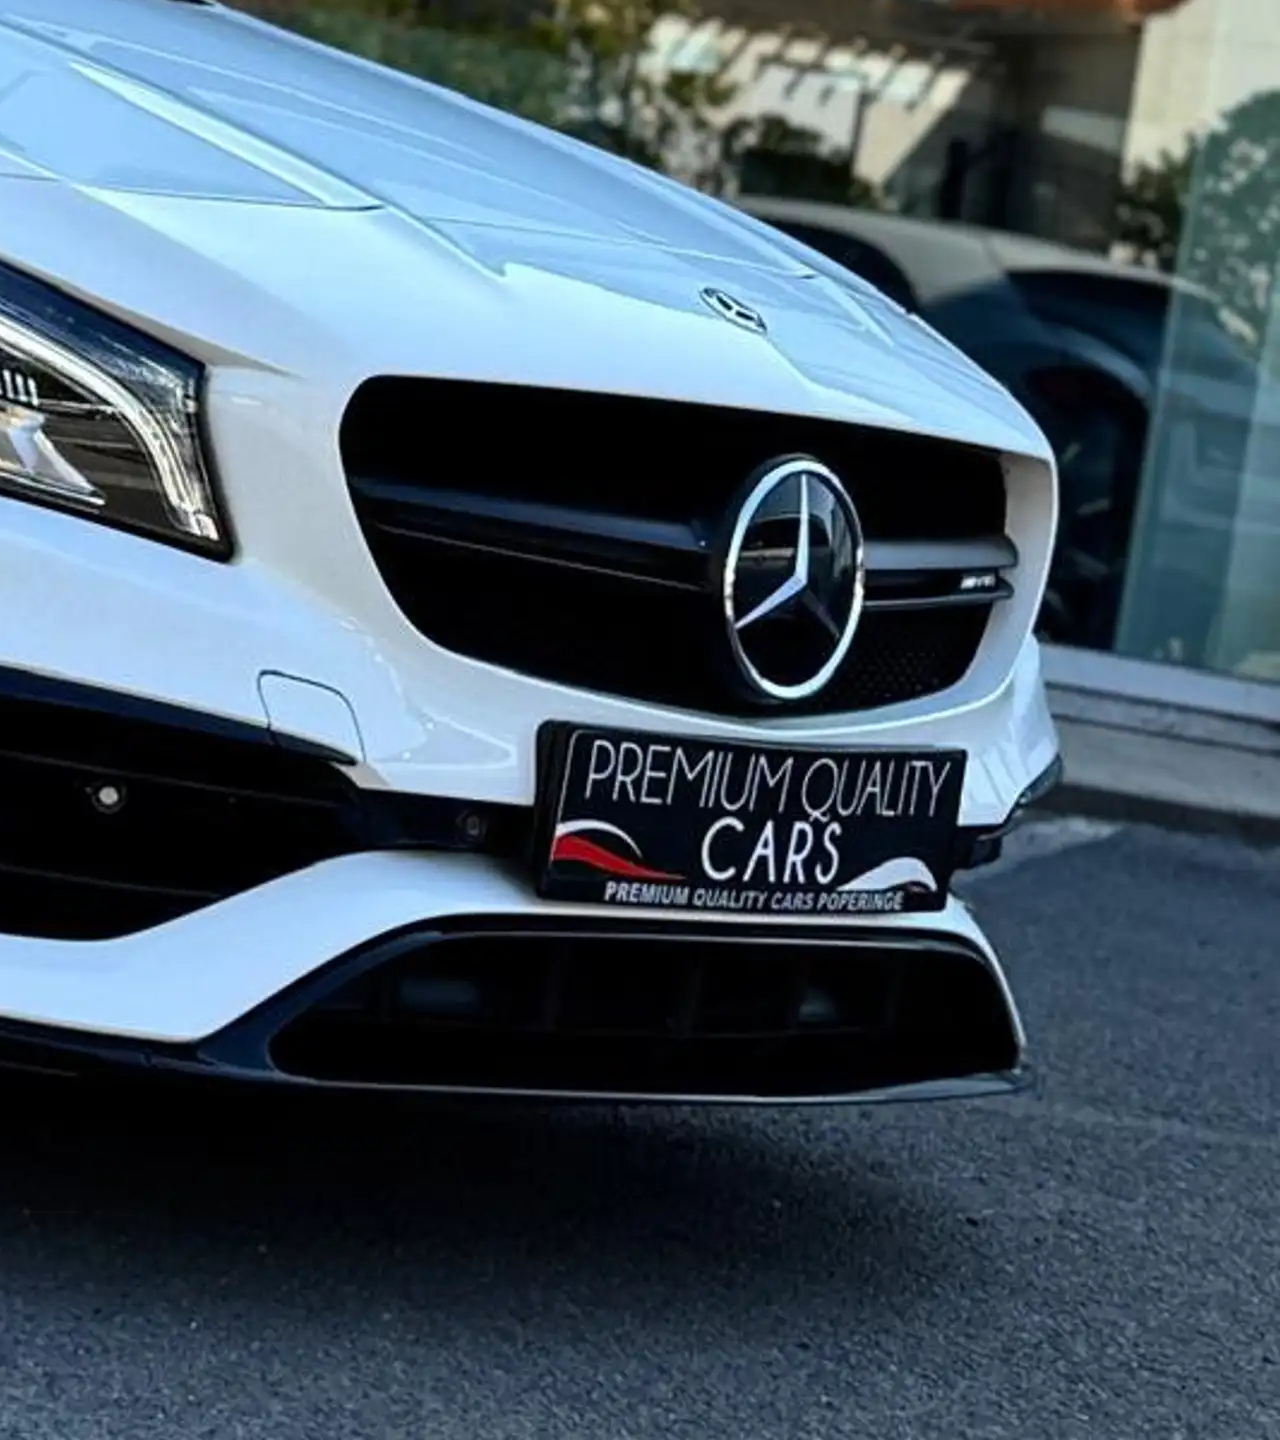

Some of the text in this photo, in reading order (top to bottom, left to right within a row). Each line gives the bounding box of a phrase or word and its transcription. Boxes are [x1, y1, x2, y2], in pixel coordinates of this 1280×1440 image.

[584, 738, 952, 823] PREMIUM QUALITY
[701, 816, 842, 885] CARS
[603, 880, 905, 911] PREMIUM QUALITY CARS POPERINGE
